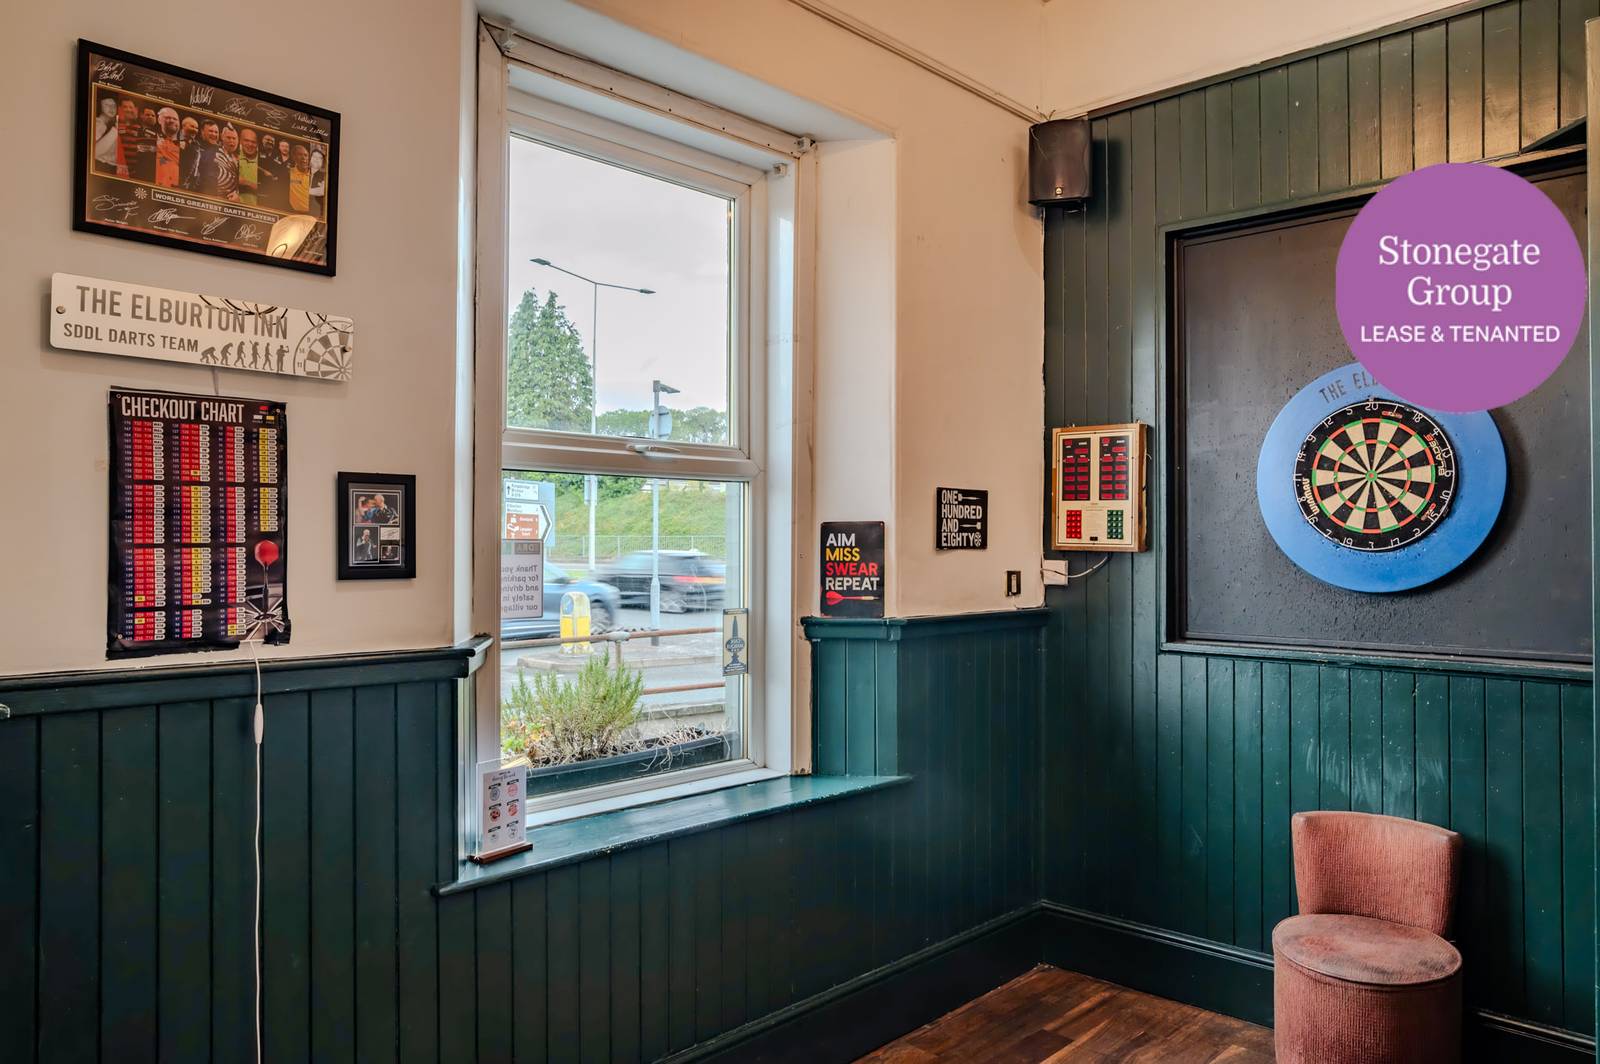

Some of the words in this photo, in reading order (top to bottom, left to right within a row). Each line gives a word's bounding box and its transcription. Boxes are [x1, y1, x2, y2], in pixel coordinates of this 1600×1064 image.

[154, 193, 185, 204] WORLDS
[186, 199, 222, 211] GREATEST
[223, 207, 246, 217] DARTS
[247, 212, 276, 223] PLAYERS
[75, 285, 122, 318] THE
[131, 293, 246, 335] ELBURTON
[253, 309, 288, 340] INN
[63, 322, 104, 342] SDDL
[108, 328, 156, 348] DARTS
[160, 334, 198, 353] TEAM
[1319, 380, 1347, 404] THE
[121, 396, 197, 420] CHECKOUT
[201, 401, 245, 423] CHART
[1365, 402, 1379, 411] 20
[1323, 417, 1334, 428] 12
[1412, 411, 1423, 423] 18
[1307, 434, 1317, 443] 9
[1296, 449, 1306, 462] 14
[941, 489, 959, 504] ONE
[1440, 490, 1451, 500] 10
[941, 504, 983, 520] HUNDRED
[1428, 511, 1440, 522] 15
[941, 519, 959, 533] AND
[826, 533, 856, 547] AIM
[941, 532, 975, 547] EIGHTY
[1343, 537, 1353, 547] 19
[825, 547, 861, 562] MISS
[825, 562, 878, 577] SWEAR
[825, 577, 880, 591] REPEAT
